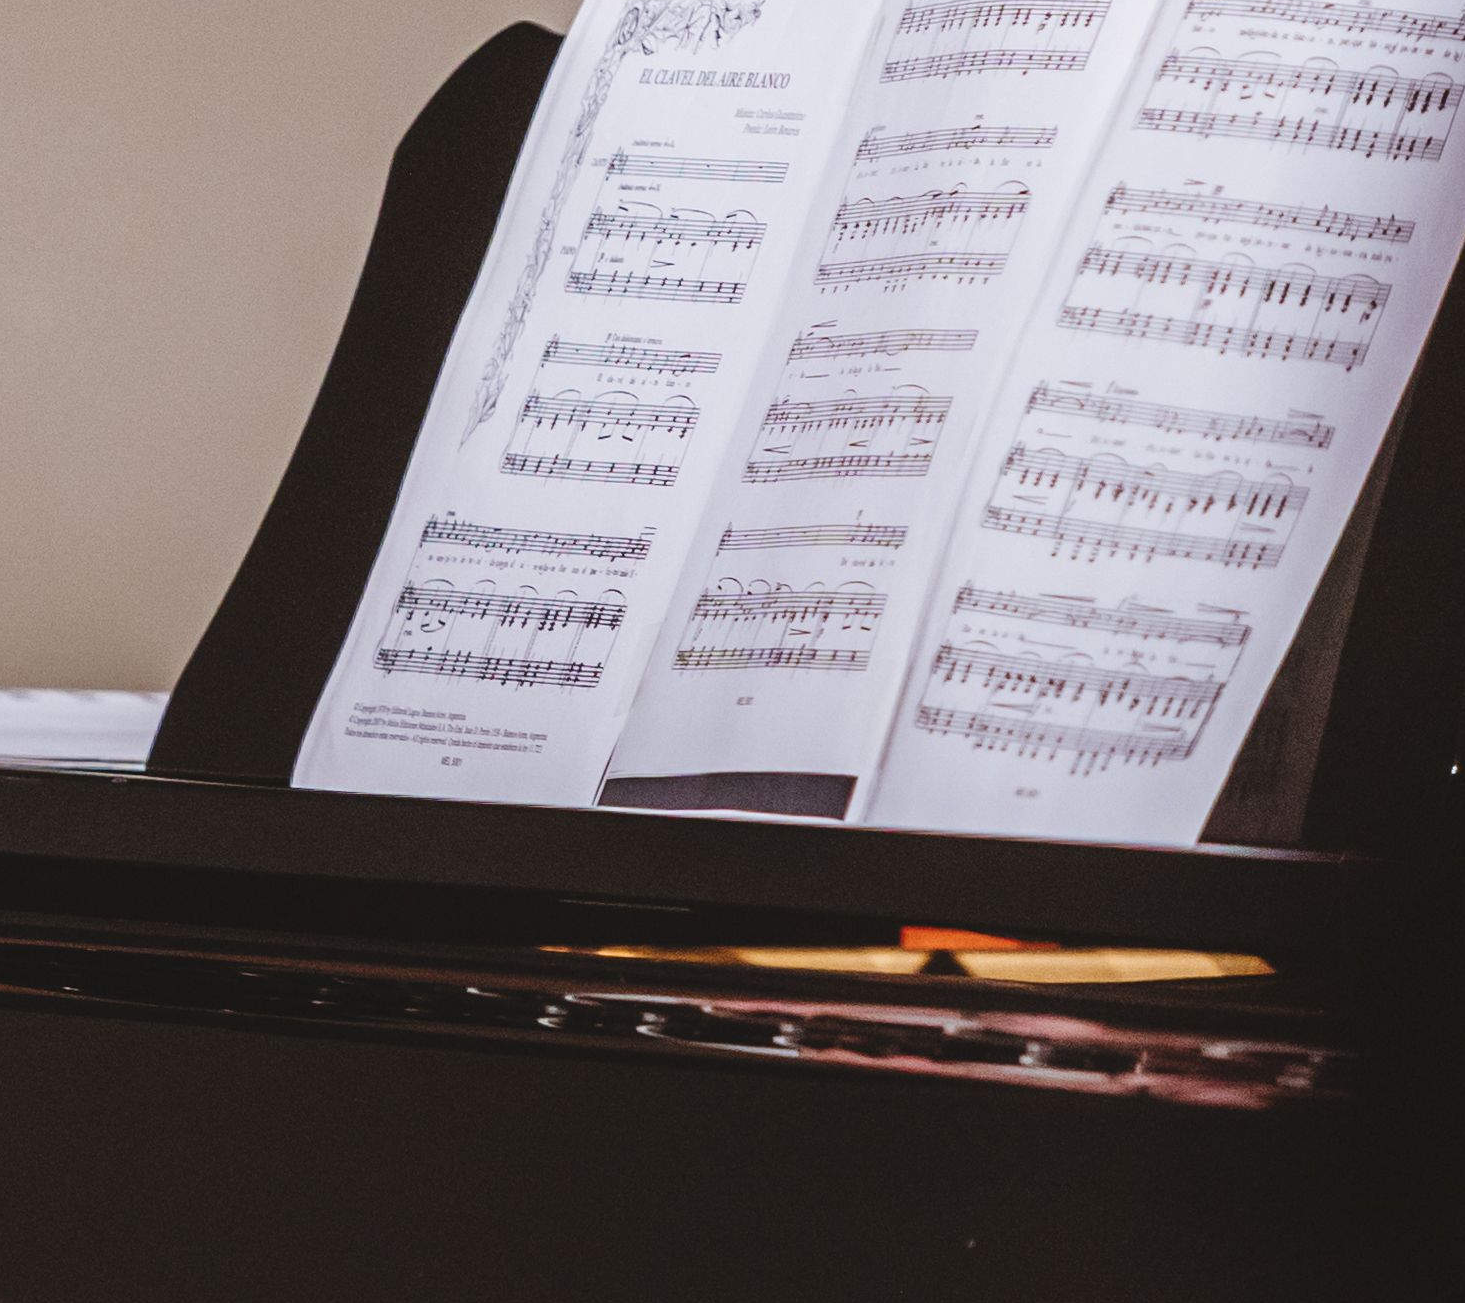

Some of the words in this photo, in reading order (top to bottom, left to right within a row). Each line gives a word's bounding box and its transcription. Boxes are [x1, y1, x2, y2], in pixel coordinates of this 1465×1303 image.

[639, 68, 653, 84] EL
[654, 69, 695, 86] CLAVEL
[696, 71, 717, 86] DEL
[719, 71, 745, 87] AIRE
[744, 72, 791, 89] BLANCO
